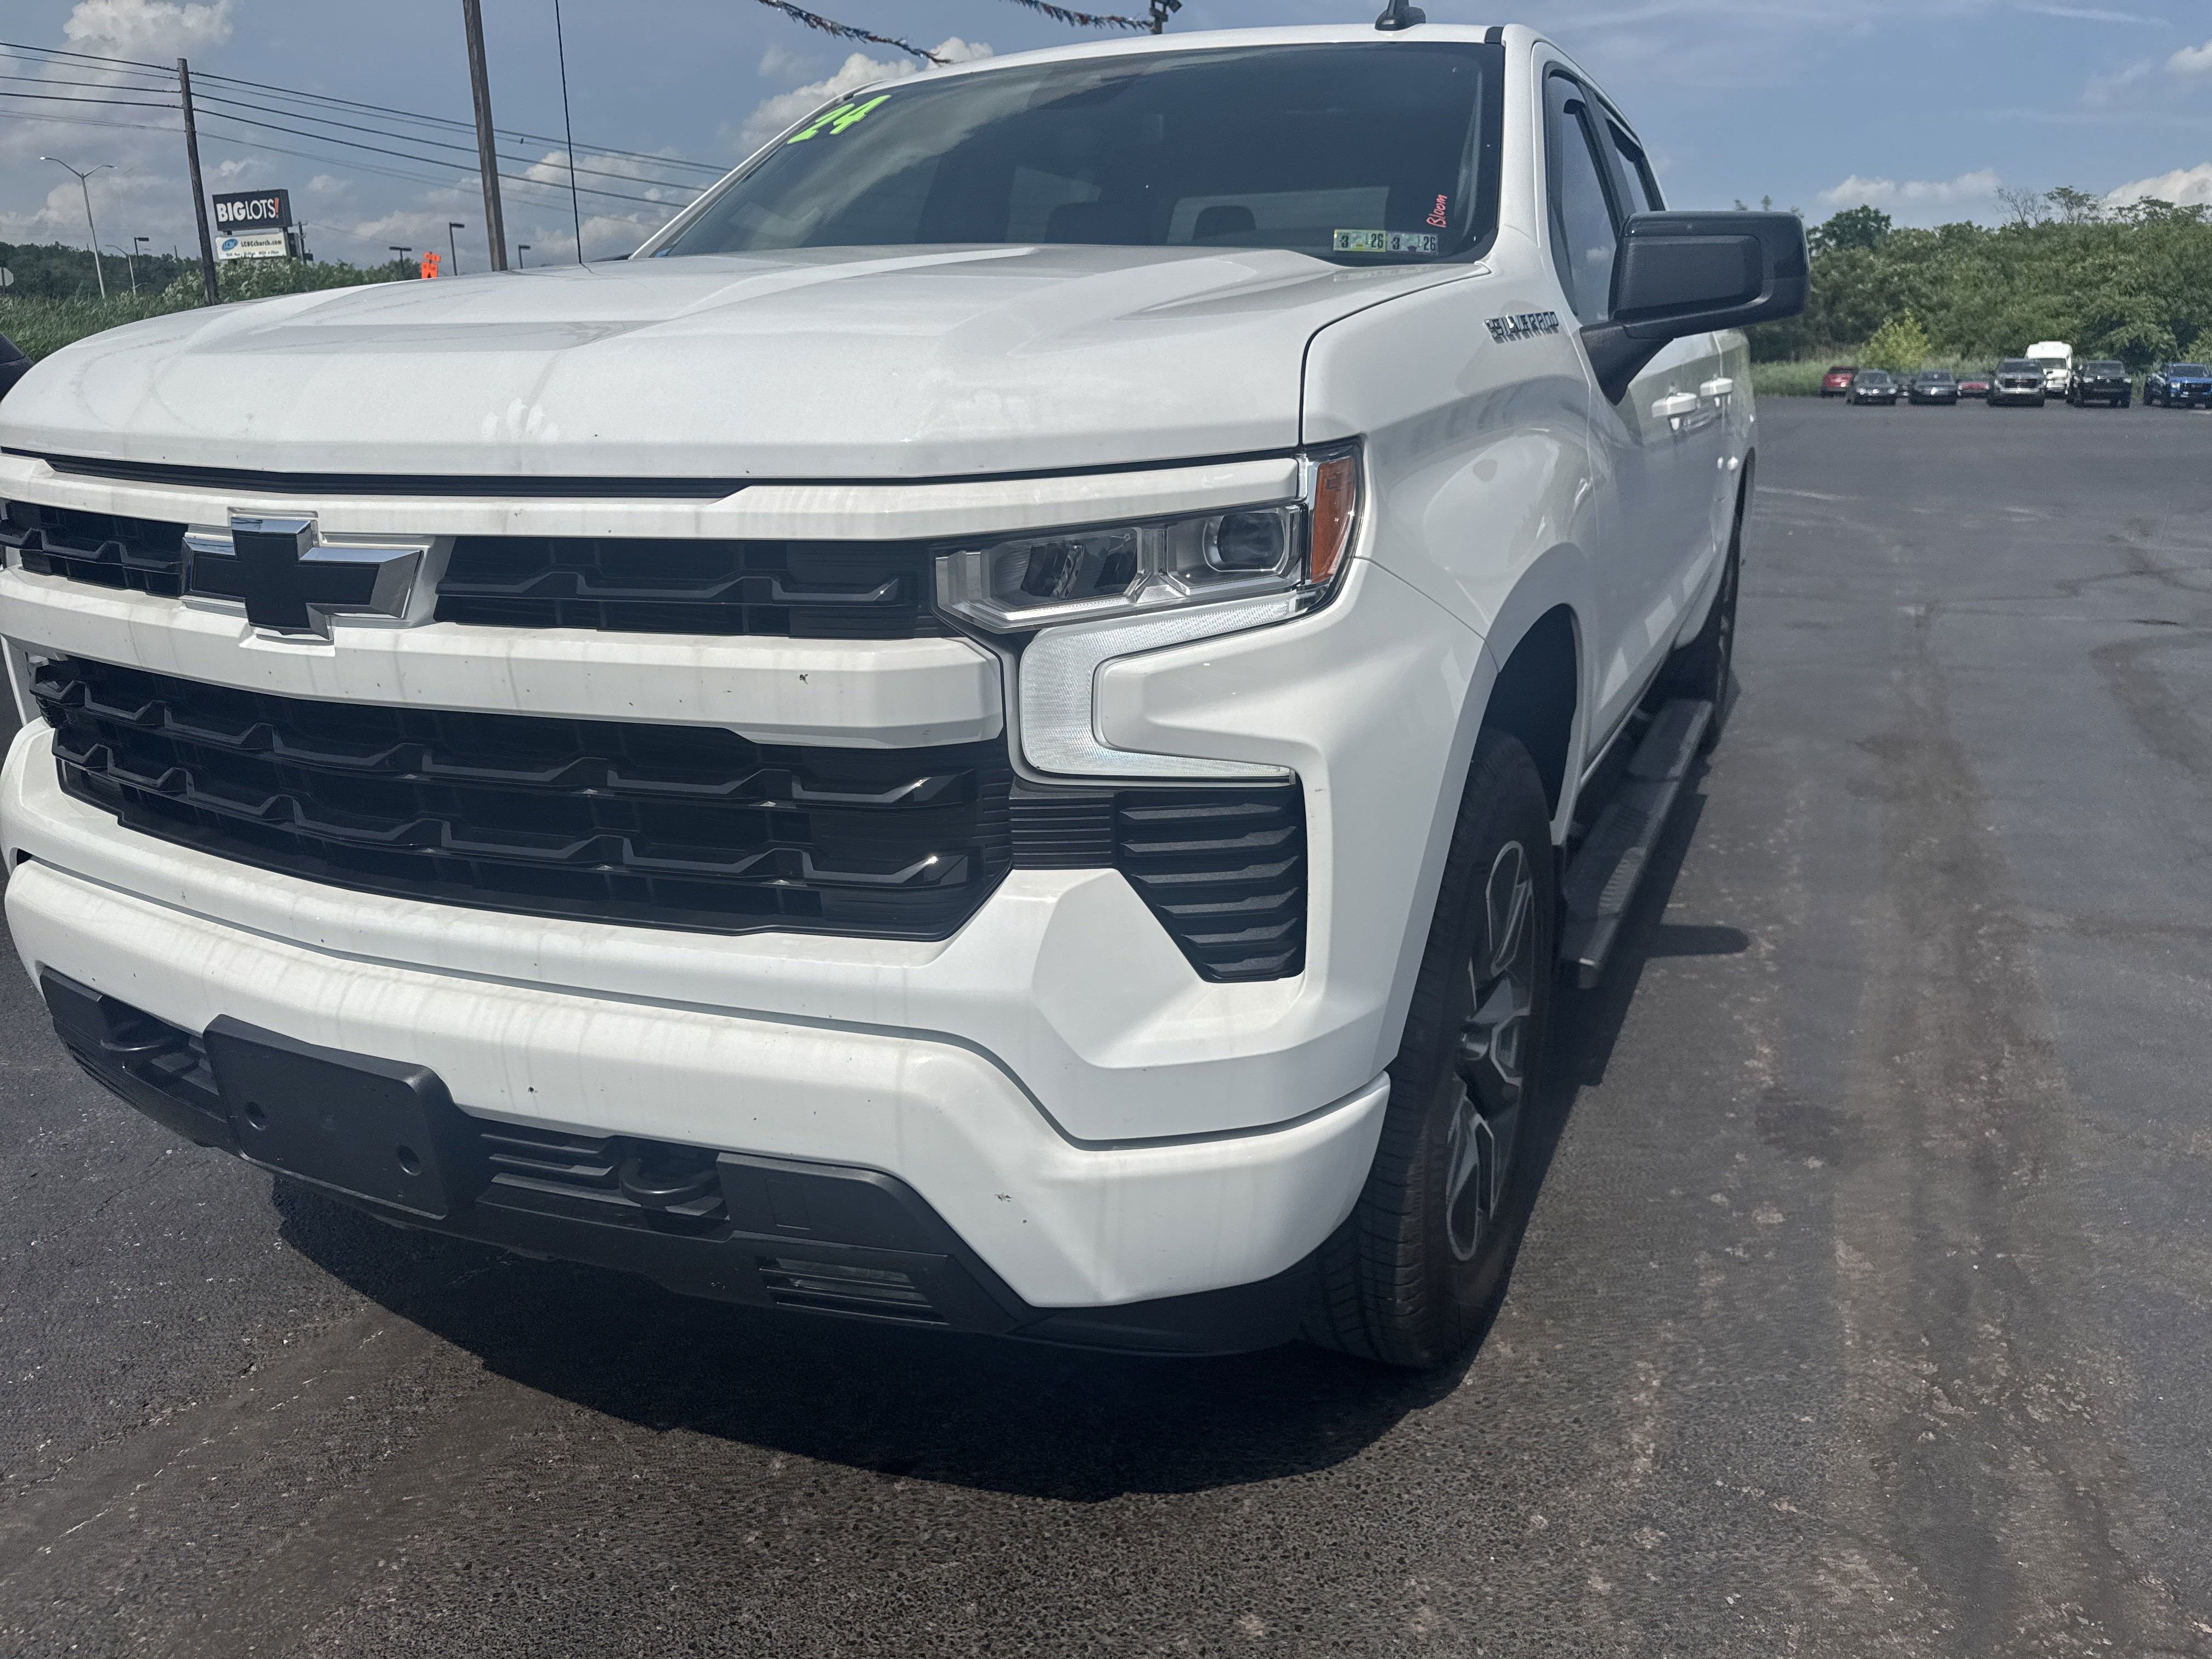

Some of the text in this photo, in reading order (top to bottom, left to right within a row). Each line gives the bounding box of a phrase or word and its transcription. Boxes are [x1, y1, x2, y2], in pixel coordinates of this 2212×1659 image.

[787, 94, 892, 144] 24
[1341, 234, 1384, 249] 3 26
[1392, 236, 1436, 251] 3 26
